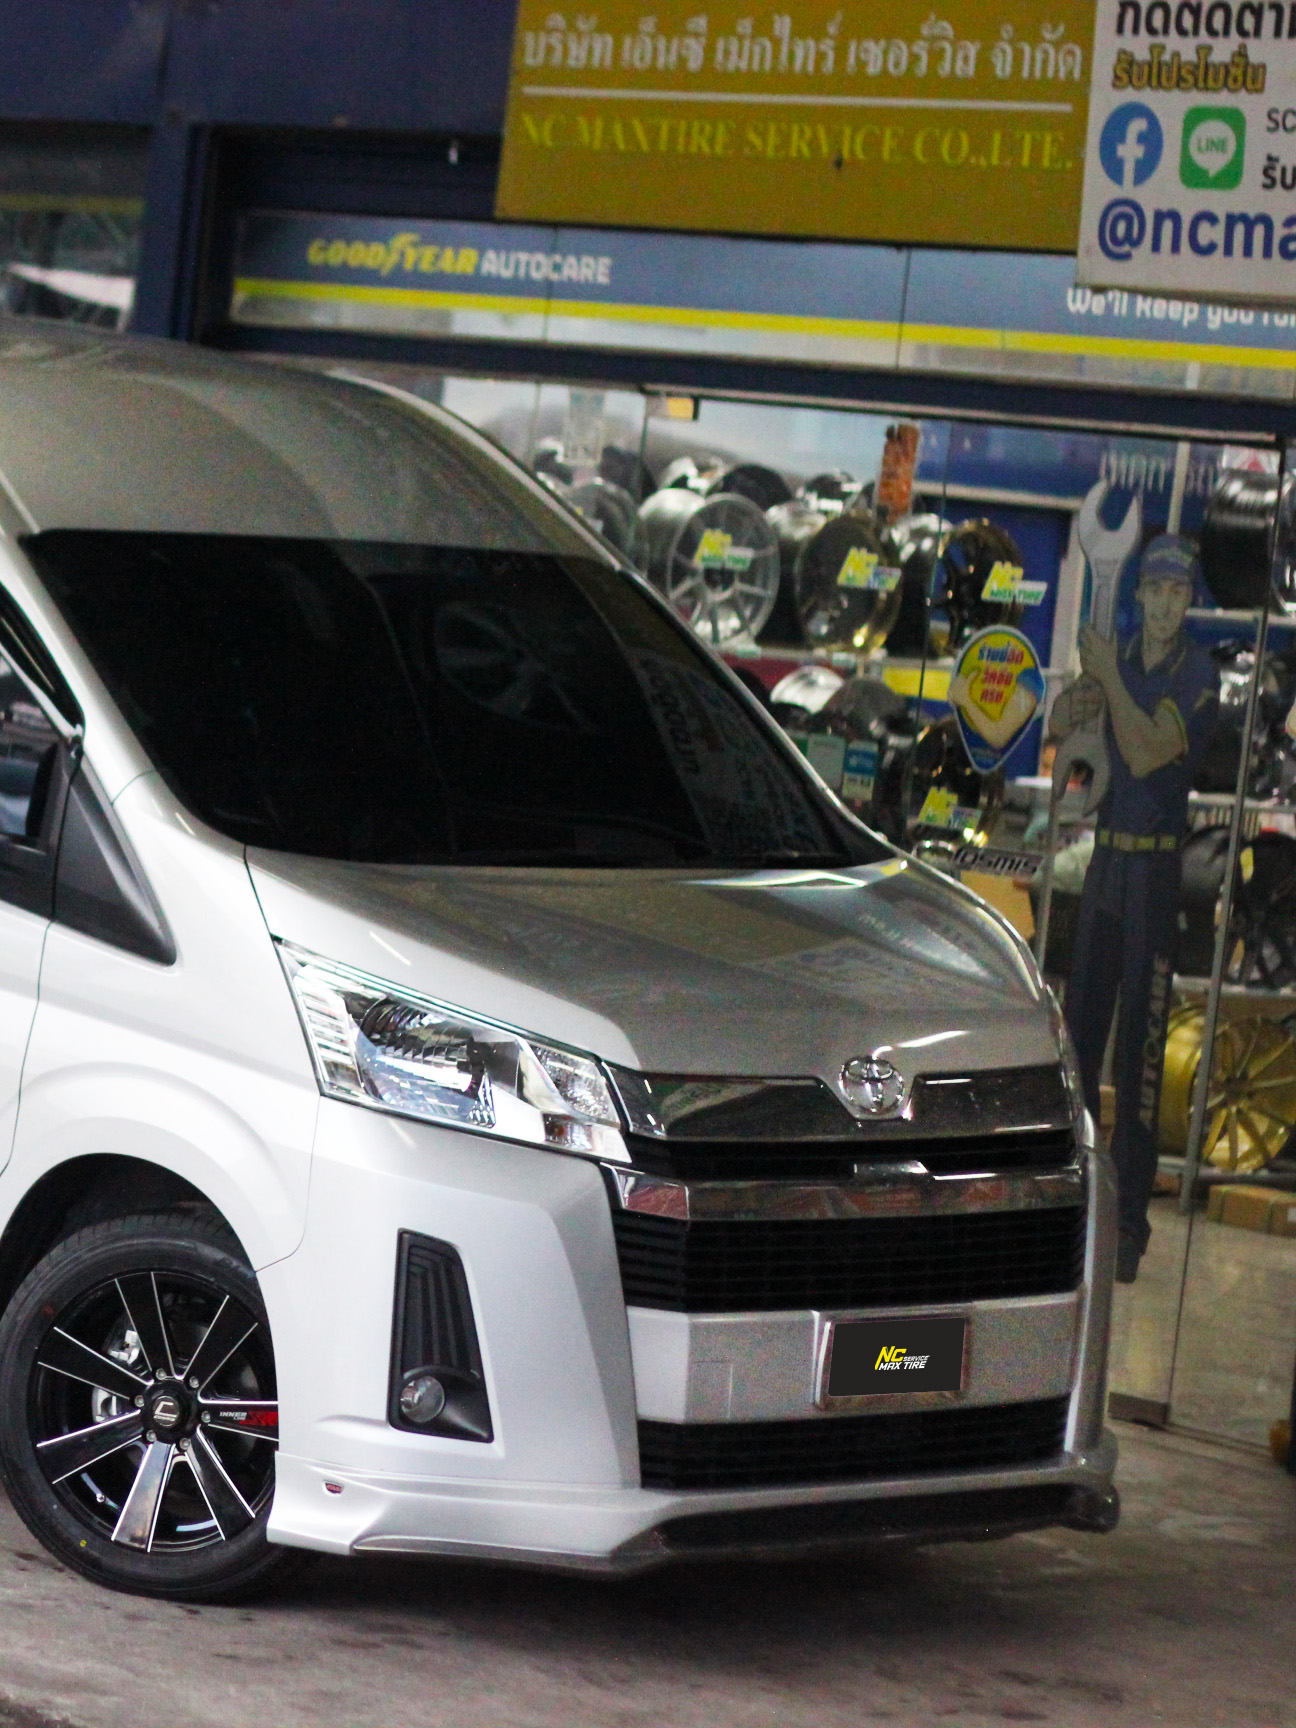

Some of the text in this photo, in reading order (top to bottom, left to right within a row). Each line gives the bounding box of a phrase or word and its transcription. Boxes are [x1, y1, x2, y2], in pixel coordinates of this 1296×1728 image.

[523, 12, 613, 70] บริษัท
[991, 22, 1082, 81] จำกัด
[746, 120, 905, 161] SERVICE
[1197, 137, 1228, 153] LINE
[307, 232, 612, 285] GOODYEAR AUTOCARE
